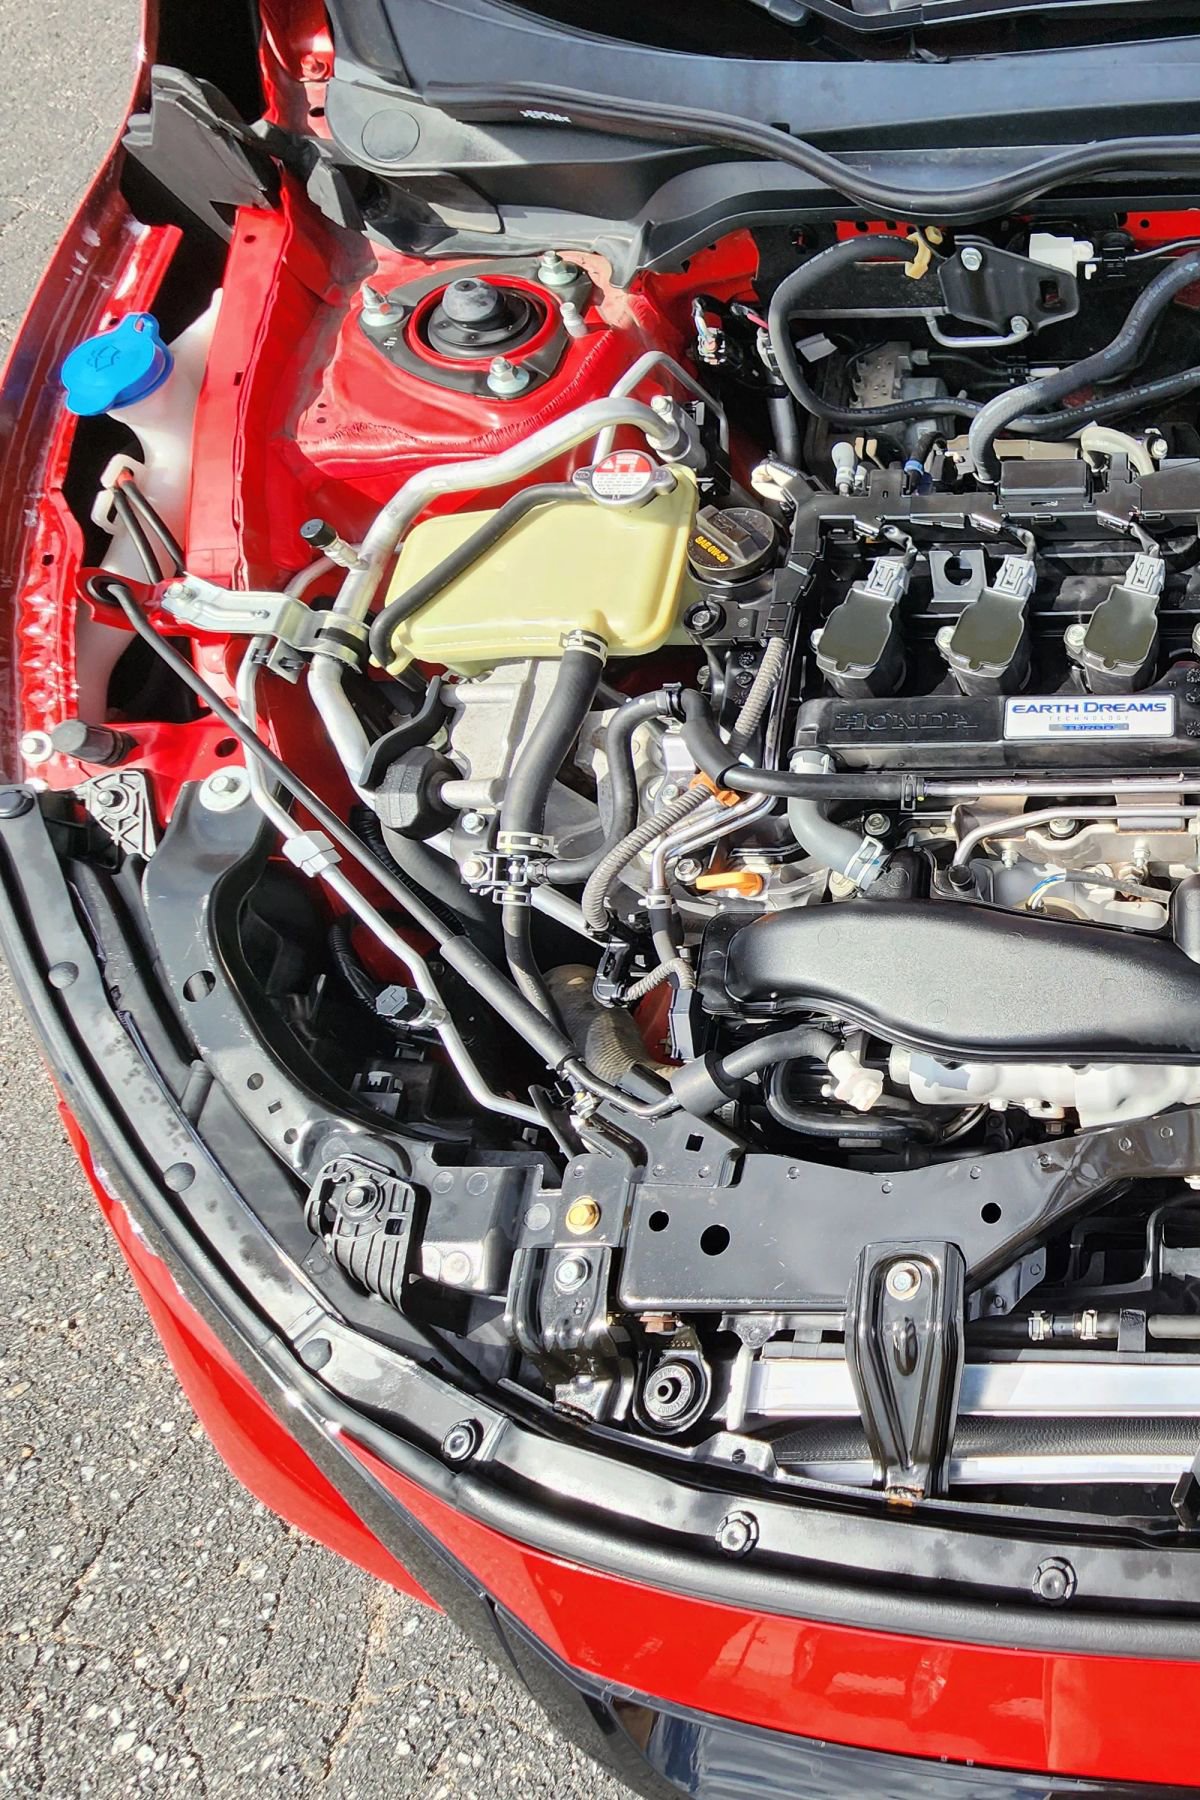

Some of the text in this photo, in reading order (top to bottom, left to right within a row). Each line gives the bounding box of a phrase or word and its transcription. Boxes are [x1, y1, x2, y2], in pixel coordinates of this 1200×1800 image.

[694, 535, 713, 550] SAE
[1011, 701, 1168, 714] EARTH DREAMS
[834, 711, 979, 732] HONDA
[1049, 714, 1130, 722] TECHNOLOGY
